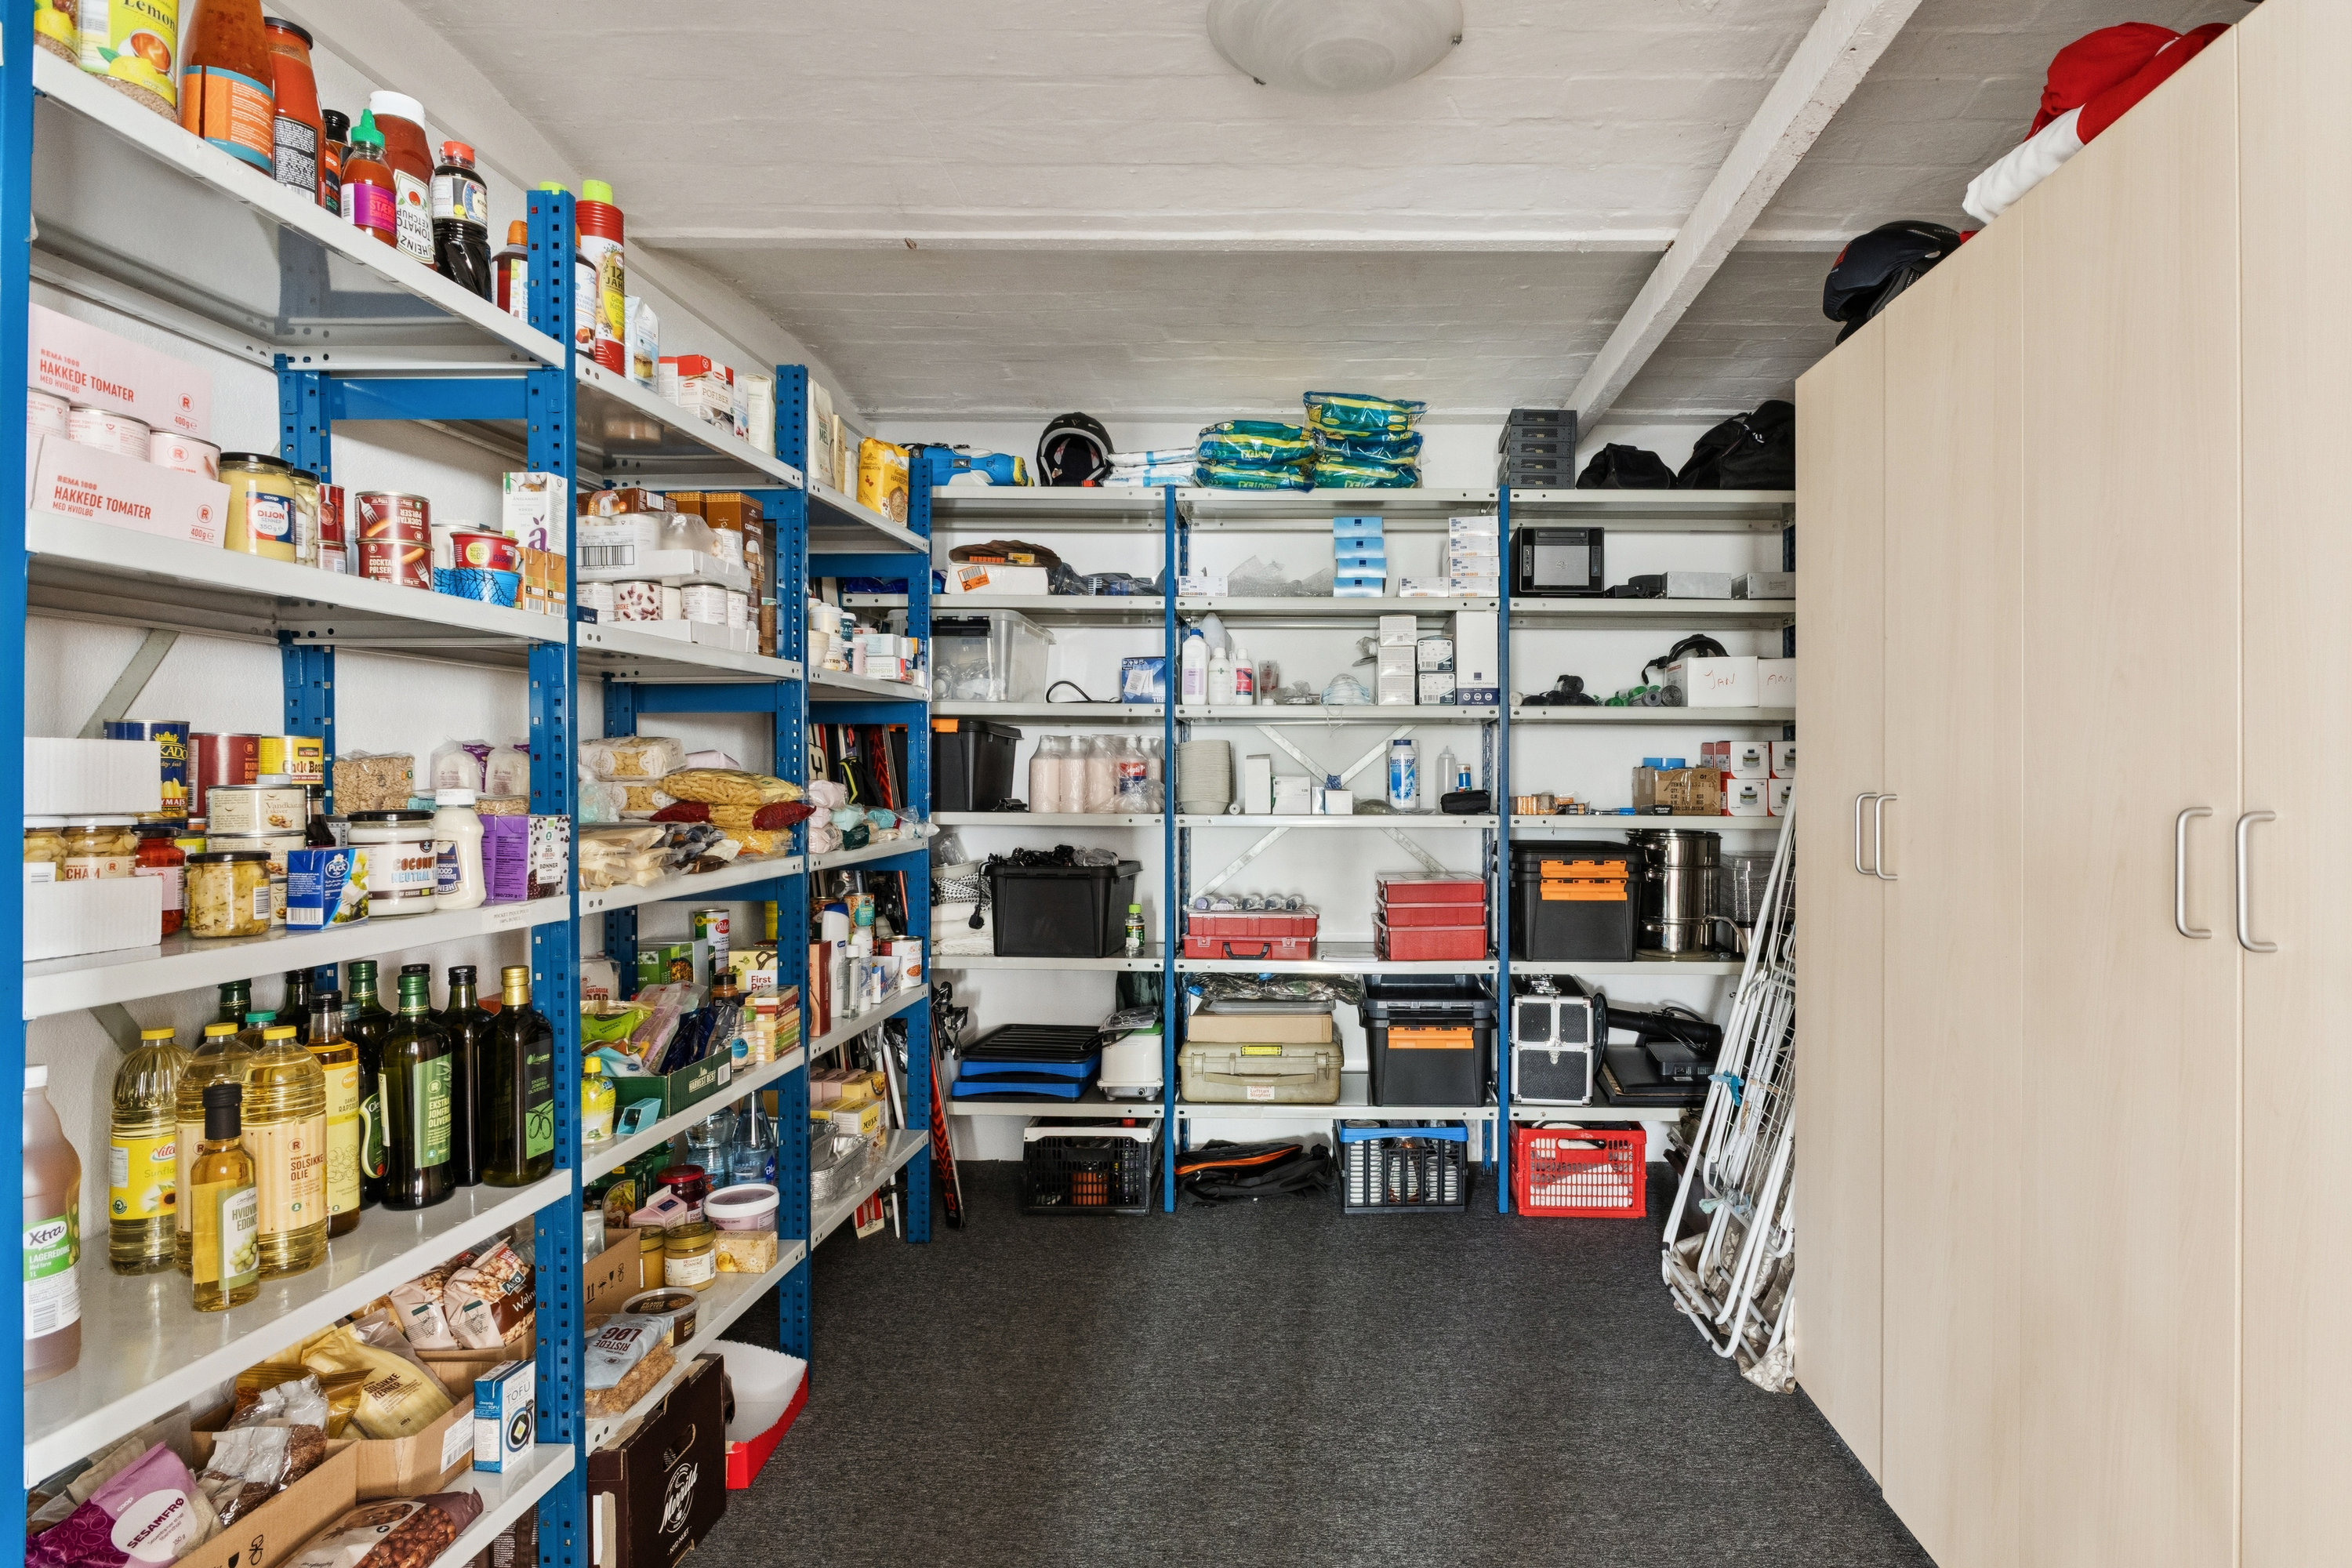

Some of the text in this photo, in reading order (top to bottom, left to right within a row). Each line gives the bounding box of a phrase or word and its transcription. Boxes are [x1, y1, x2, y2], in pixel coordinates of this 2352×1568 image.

[400, 234, 430, 257] HEINZ
[40, 348, 63, 362] REMA
[40, 358, 135, 403] HAKKEDE TOMATER
[40, 375, 80, 394] MED HVIDLØG
[702, 387, 730, 405] POFIBER
[56, 475, 79, 487] REMA
[53, 501, 93, 517] MED HVIDLØG
[54, 485, 151, 520] HAKKEDE TOMATER
[257, 510, 285, 520] DIJON
[160, 748, 188, 760] KADO
[328, 862, 347, 873] Puck
[392, 855, 436, 871] COCONUT
[390, 871, 430, 884] NEUTRAL
[862, 1115, 878, 1131] HUSK
[290, 1153, 324, 1171] SOLSIKKE
[143, 1166, 175, 1178] Sunflo
[290, 1169, 309, 1181] OLIE
[29, 1225, 65, 1247] Xtra
[601, 1327, 643, 1343] LØG
[594, 1339, 631, 1352] RISTEDE
[364, 1372, 401, 1394] SOLSIKKE
[371, 1381, 404, 1402] KERNER
[506, 1381, 531, 1404] TOFU
[117, 1497, 134, 1512] coop
[658, 1462, 699, 1534] Merrild
[126, 1497, 185, 1549] SESAMFRØ
